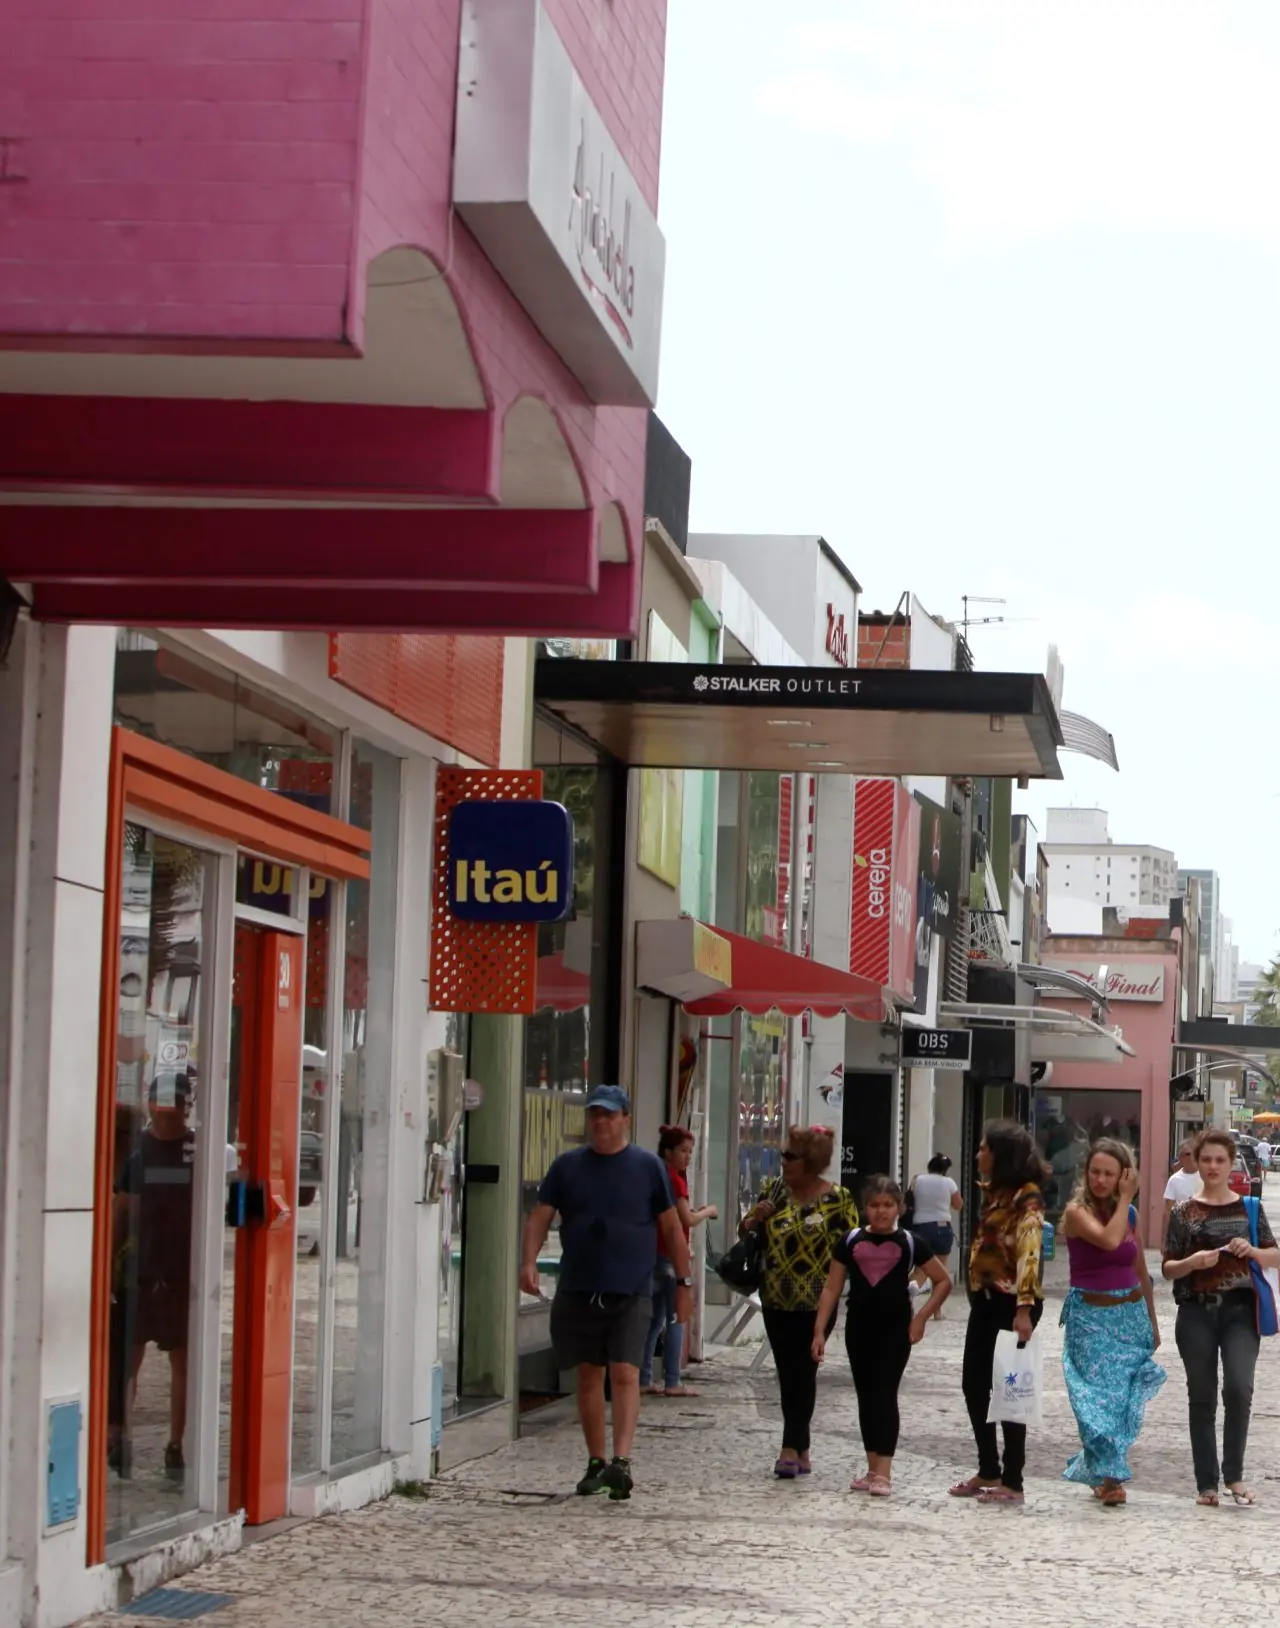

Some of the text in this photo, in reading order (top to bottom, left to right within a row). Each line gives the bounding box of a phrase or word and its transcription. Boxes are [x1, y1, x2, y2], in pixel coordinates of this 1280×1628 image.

[710, 676, 862, 694] STALKER OUTLET
[456, 859, 558, 904] Itaú
[867, 848, 891, 919] cereja
[1106, 973, 1160, 995] Final
[918, 1032, 948, 1049] OBS
